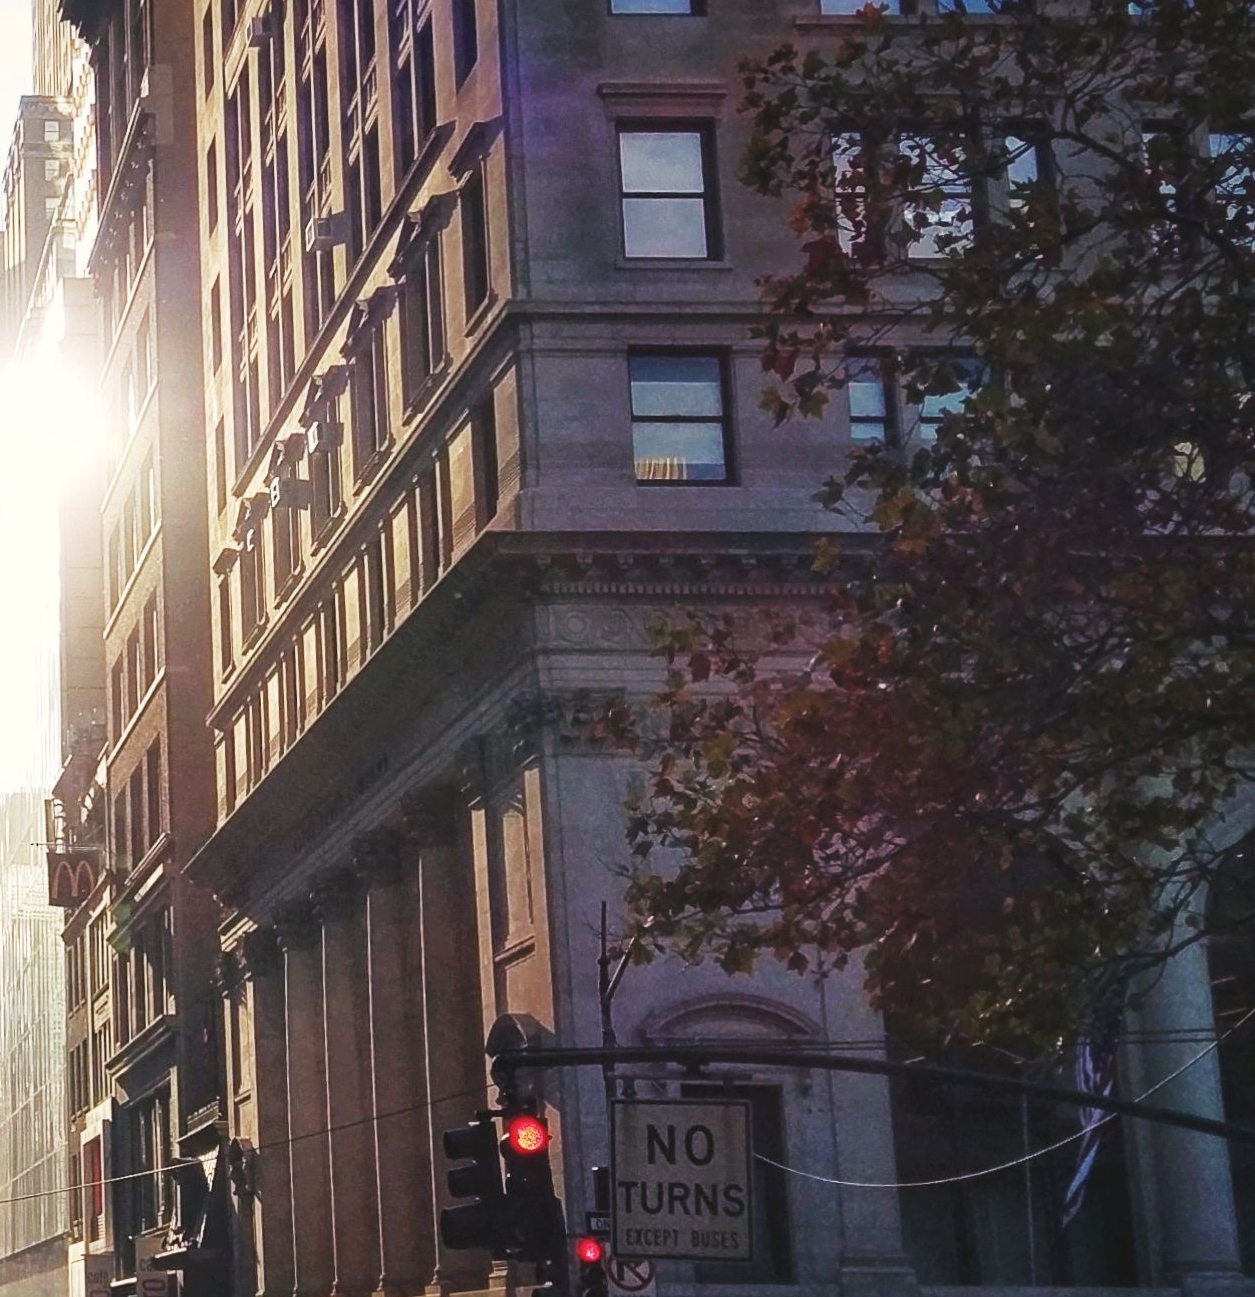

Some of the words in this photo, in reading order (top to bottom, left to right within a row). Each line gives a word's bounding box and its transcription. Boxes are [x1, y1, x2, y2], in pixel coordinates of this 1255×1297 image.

[646, 1124, 715, 1166] NO
[618, 1181, 746, 1217] TURNS
[626, 1228, 679, 1247] EXCEPT
[691, 1230, 740, 1250] BUSES
